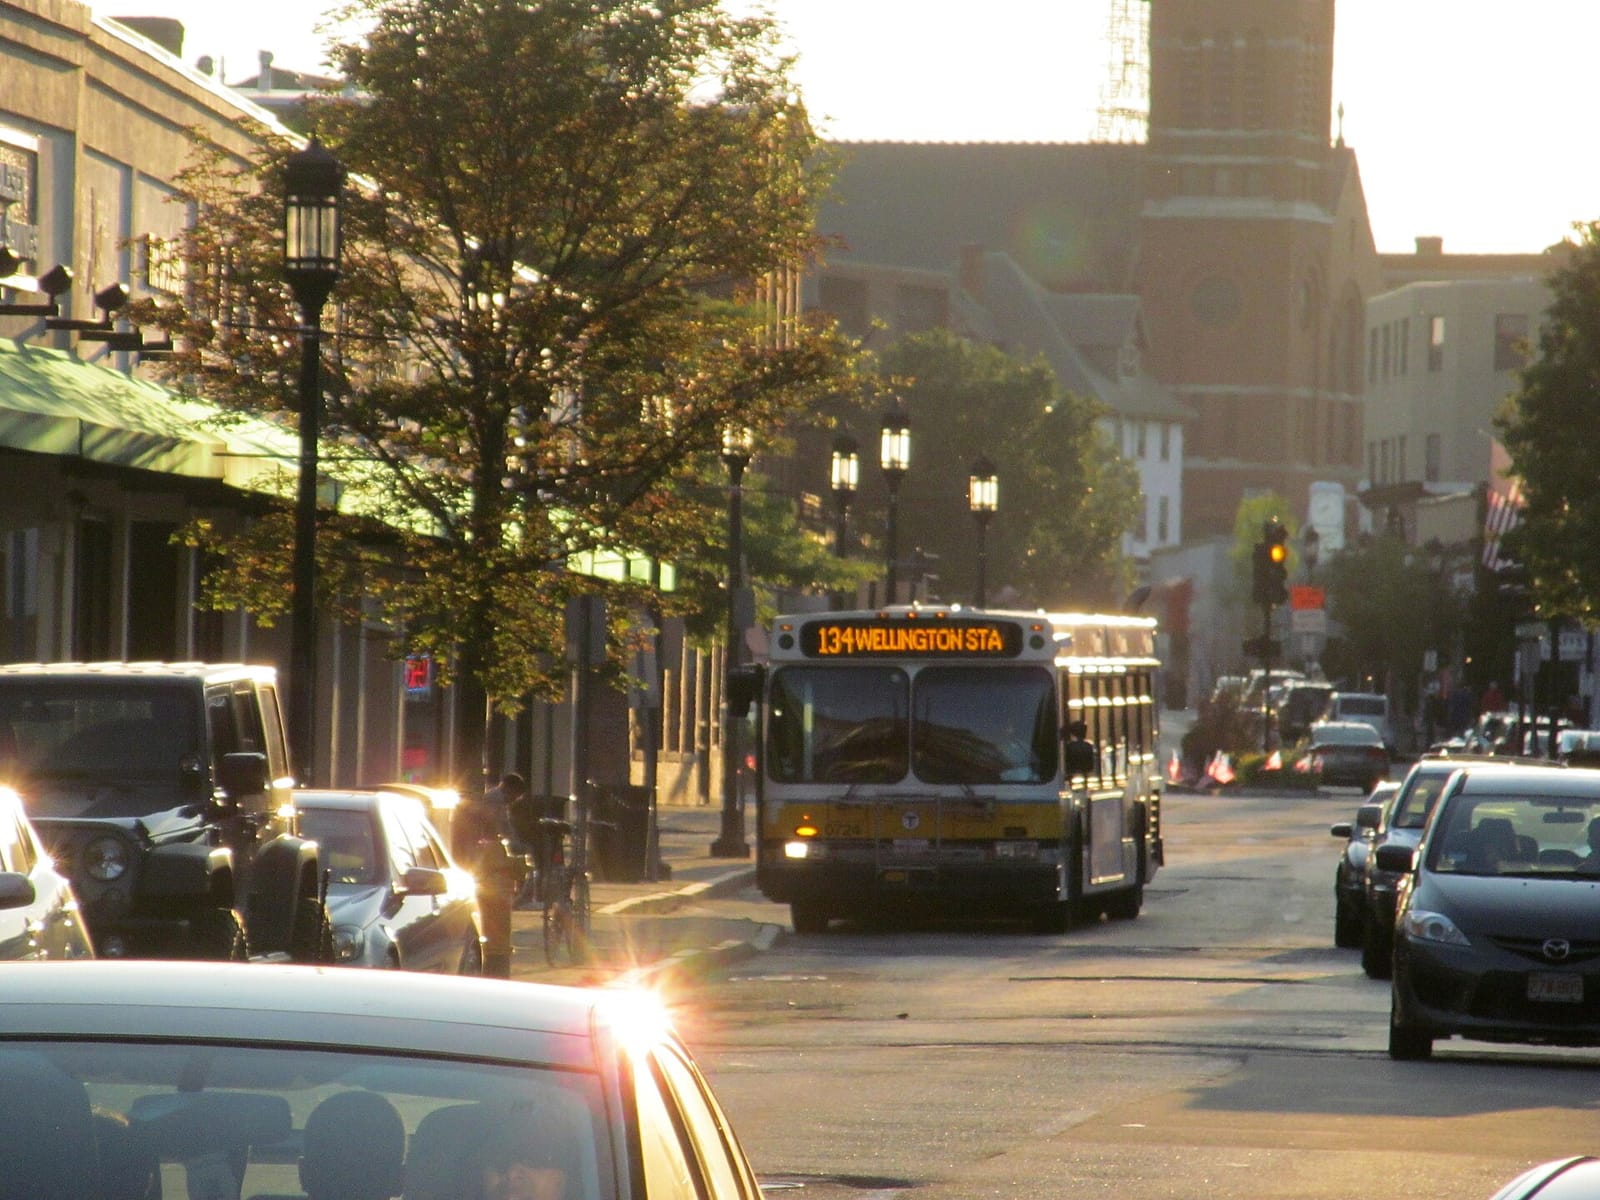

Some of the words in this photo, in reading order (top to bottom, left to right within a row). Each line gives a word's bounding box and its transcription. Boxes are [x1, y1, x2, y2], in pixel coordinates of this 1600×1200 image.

[818, 627, 854, 654] 134
[855, 627, 963, 651] WELLINGTON
[965, 628, 1003, 651] STA
